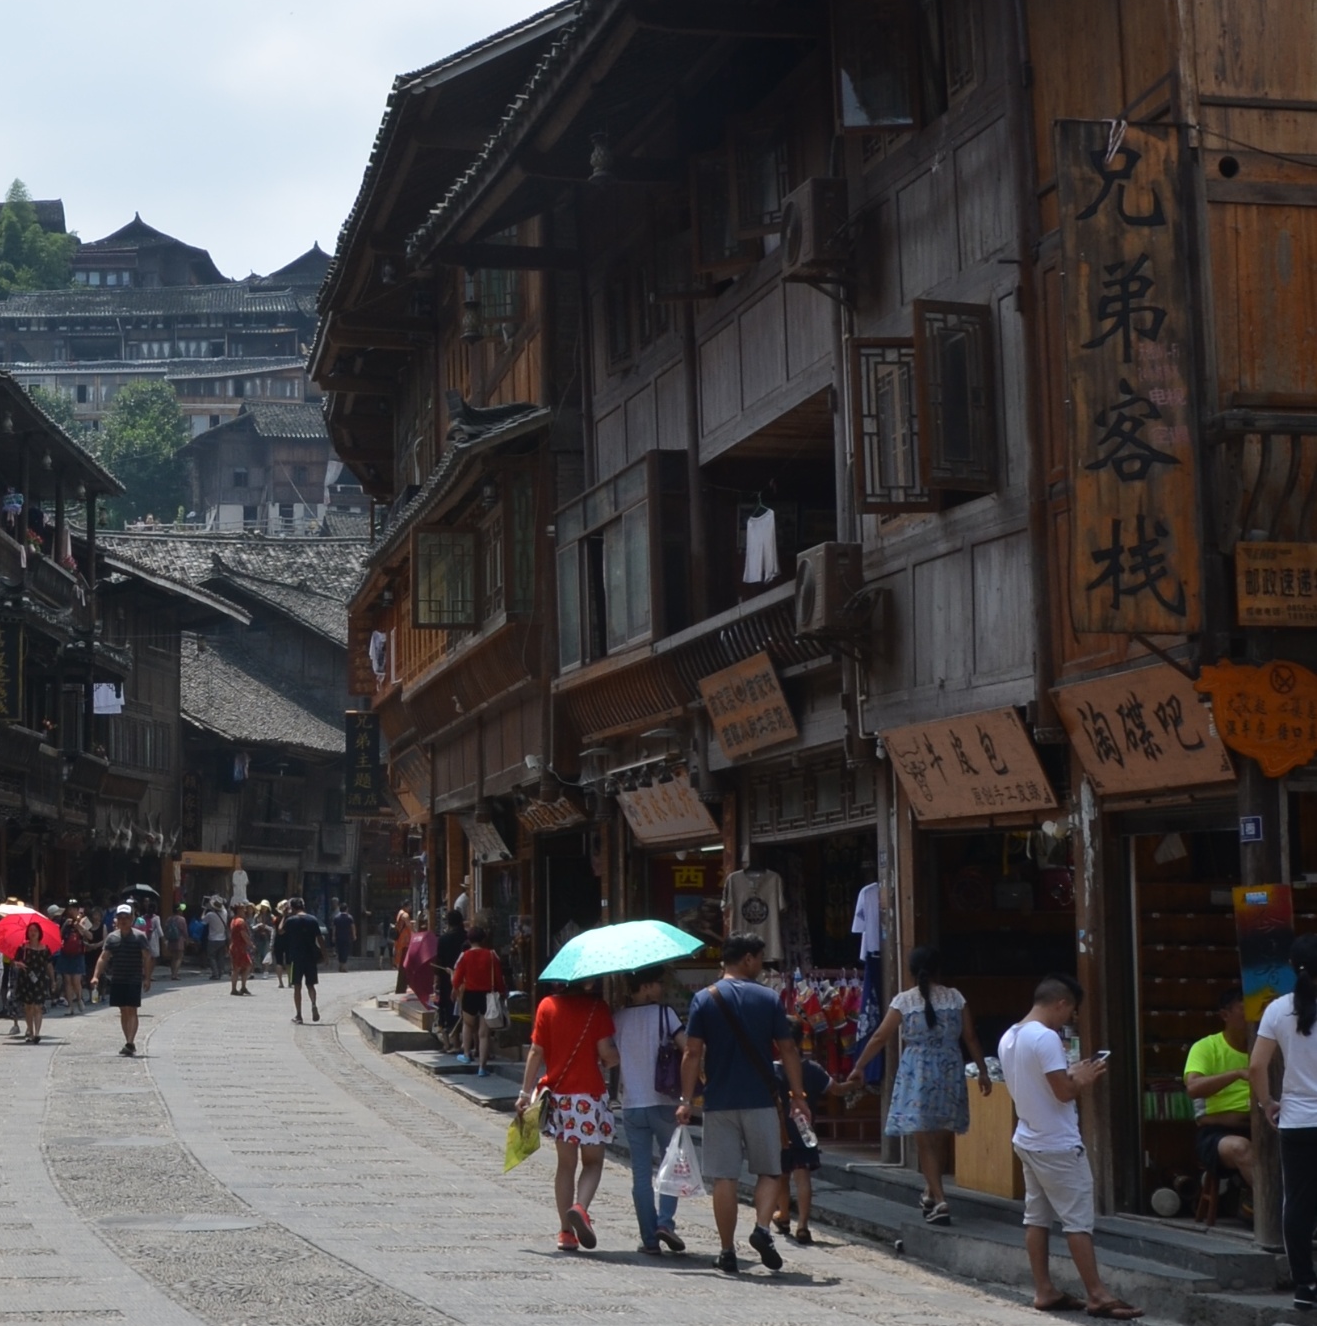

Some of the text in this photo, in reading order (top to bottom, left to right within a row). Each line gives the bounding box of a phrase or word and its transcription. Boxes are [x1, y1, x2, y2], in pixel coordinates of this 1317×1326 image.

[1075, 147, 1187, 617] 兄弟客栈
[1245, 567, 1317, 597] 邮政速递
[354, 714, 373, 789] 兄弟主题
[923, 724, 1008, 783] 牛皮包
[348, 794, 377, 807] 酒店
